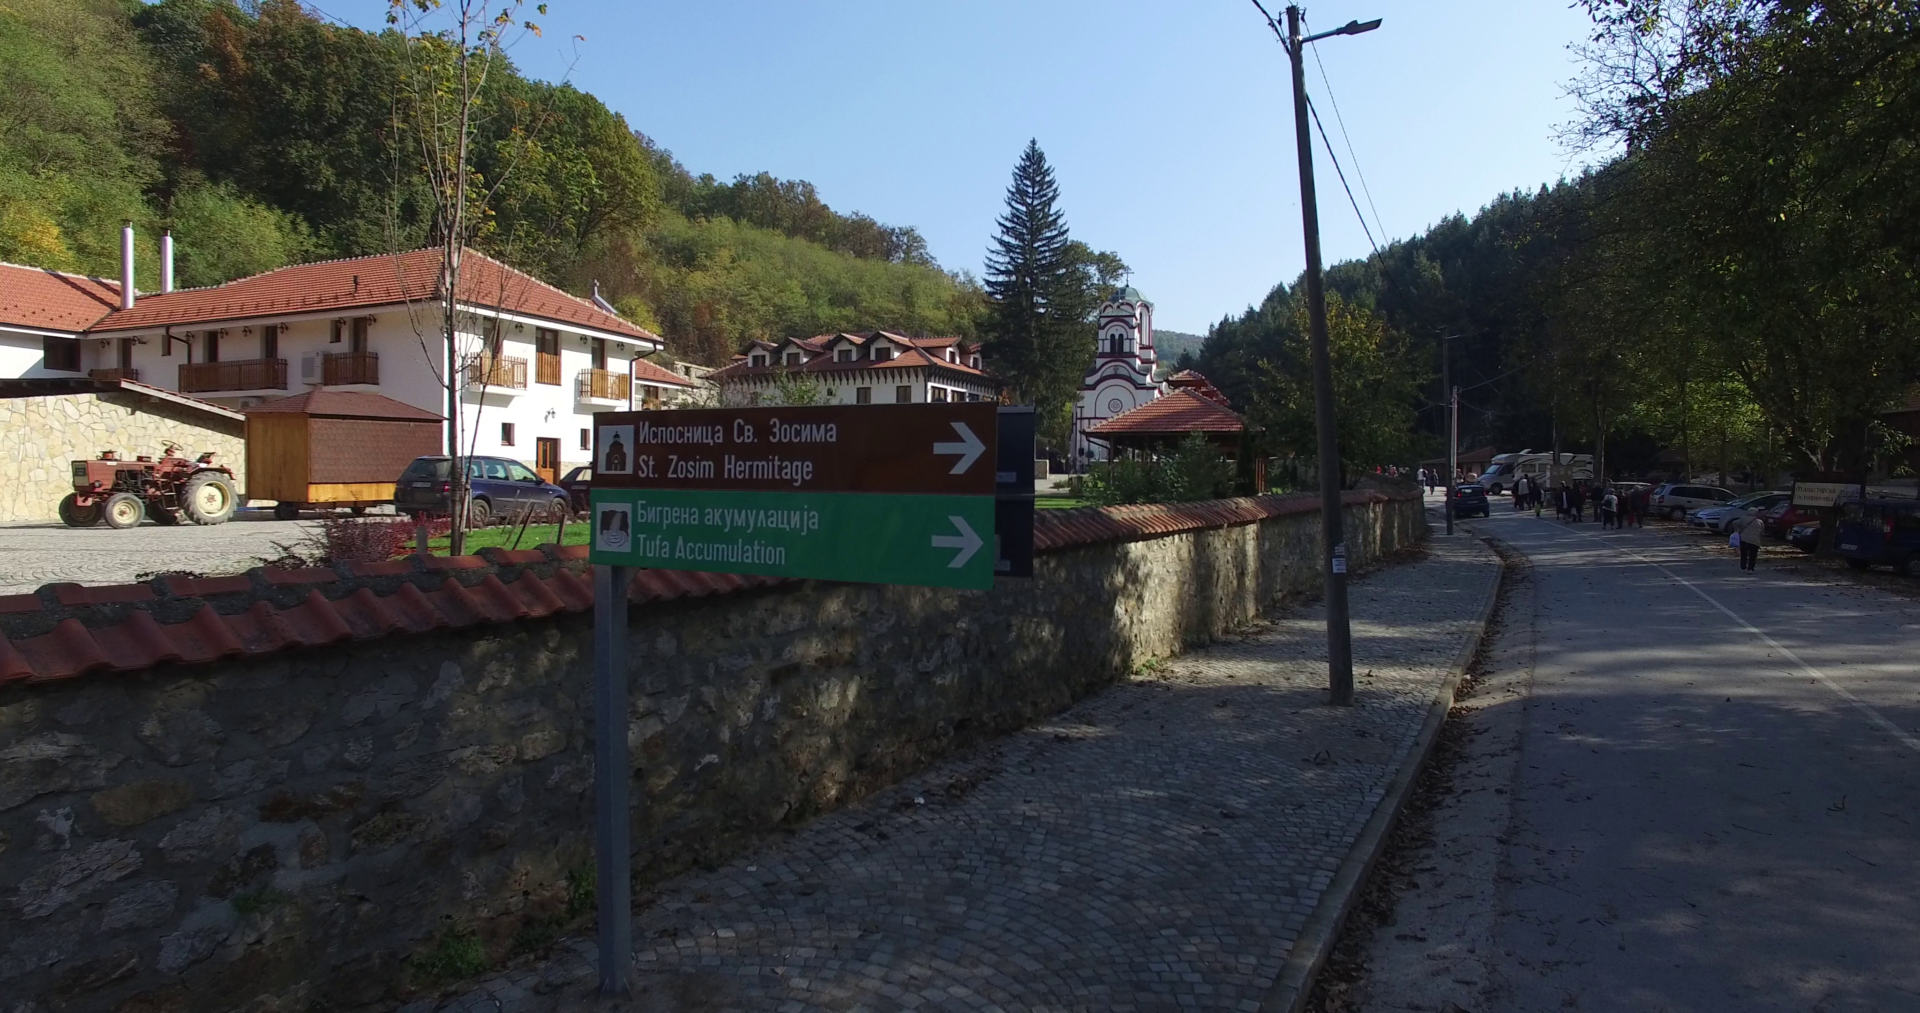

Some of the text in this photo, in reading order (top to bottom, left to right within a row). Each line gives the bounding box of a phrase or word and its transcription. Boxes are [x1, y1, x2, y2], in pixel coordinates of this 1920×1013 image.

[640, 417, 836, 445] Испосница Св. Зосима
[639, 455, 812, 486] St. Zosim Hermitage
[638, 500, 818, 535] Бигрена акумулација
[638, 535, 785, 564] Tufa Accumulation
